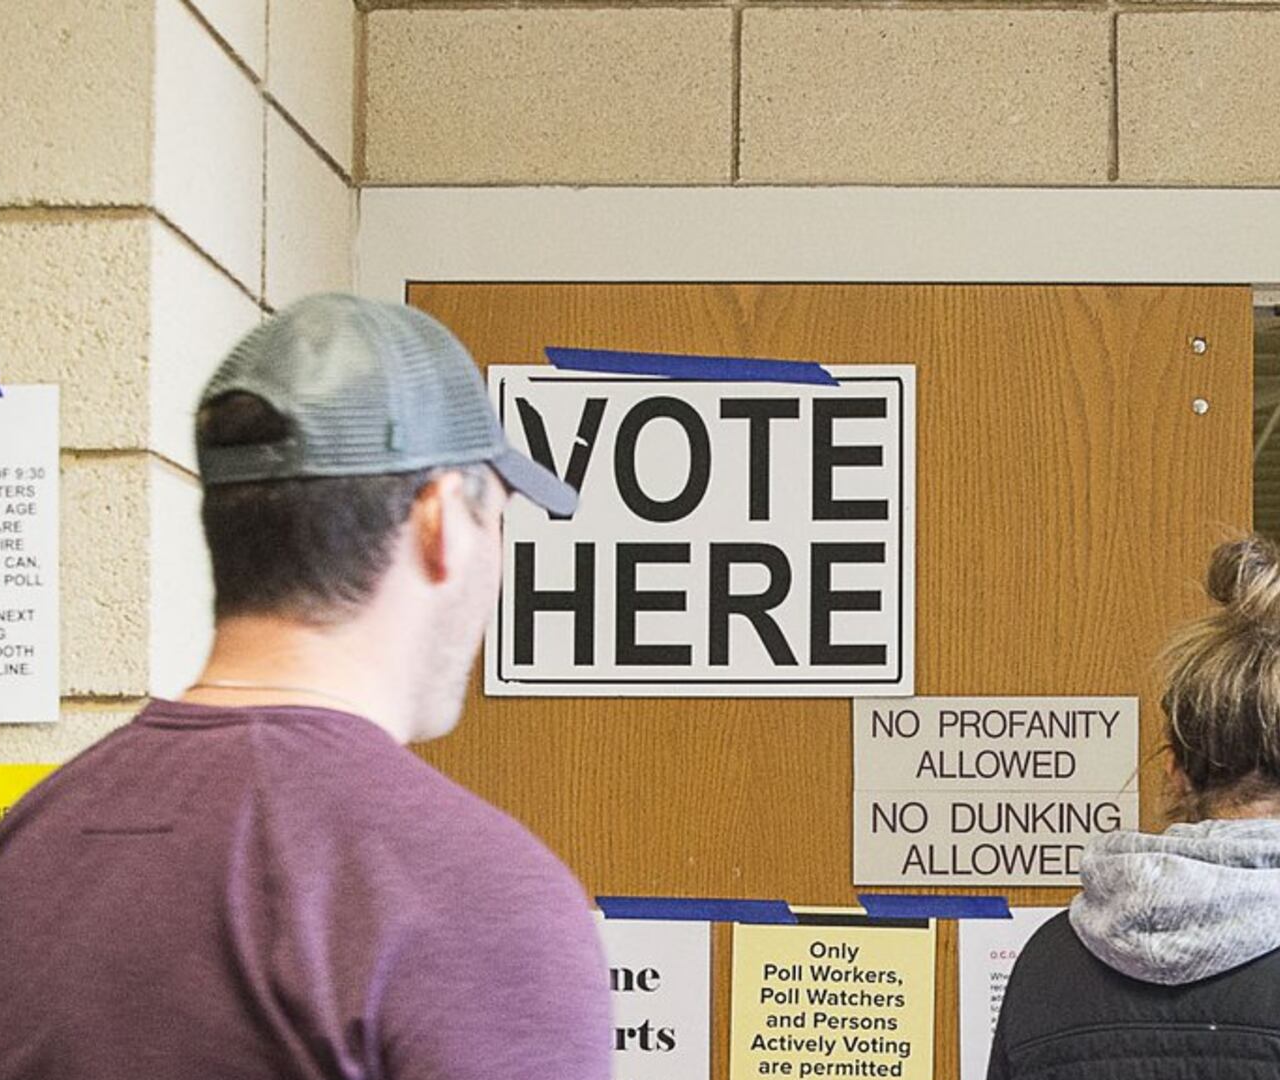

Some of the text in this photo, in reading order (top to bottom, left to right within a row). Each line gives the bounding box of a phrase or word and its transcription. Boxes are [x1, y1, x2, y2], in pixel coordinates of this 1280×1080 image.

[516, 396, 889, 522] VOTE
[5, 503, 34, 515] AGE
[4, 574, 42, 586] POLL
[513, 541, 887, 666] HERE
[872, 710, 1120, 738] NO PROFANITY
[916, 750, 1076, 778] ALLOWED
[872, 802, 1121, 833] NO DUNKING
[901, 844, 1086, 876] ALLOWED
[810, 941, 859, 963] Only
[610, 967, 661, 993] ne
[764, 964, 903, 985] Poll Workers,
[760, 987, 905, 1007] Poll Watchers
[766, 1012, 897, 1030] and Persons
[614, 1018, 677, 1052] rts
[750, 1034, 911, 1058] Actively Voting
[758, 1061, 902, 1078] are permitted
